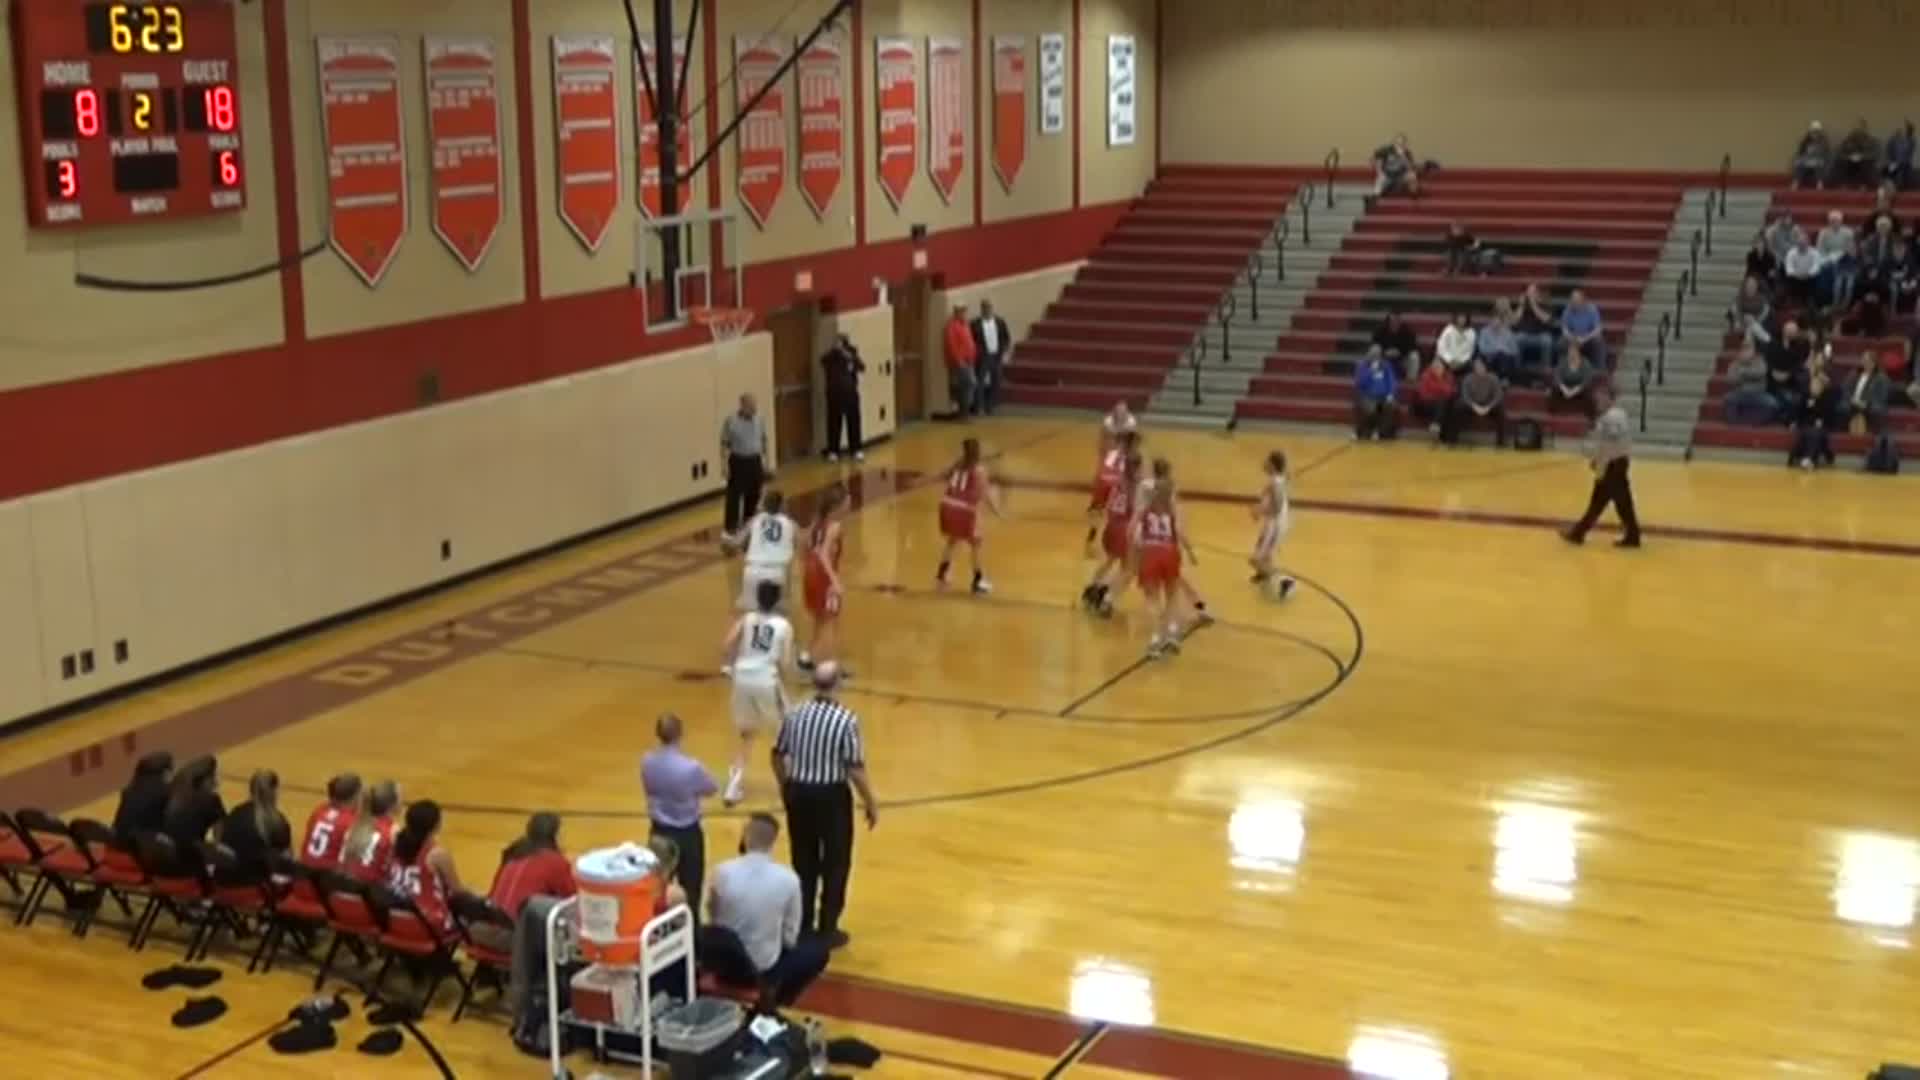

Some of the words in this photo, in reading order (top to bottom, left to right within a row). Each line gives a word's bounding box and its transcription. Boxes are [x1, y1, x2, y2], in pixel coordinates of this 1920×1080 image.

[43, 61, 91, 84] HOME
[182, 60, 229, 83] GUEST
[75, 90, 99, 136] 8
[134, 93, 151, 129] 2
[205, 87, 235, 131] 18
[58, 160, 76, 197] 3
[220, 151, 238, 185] 6
[308, 820, 335, 858] 5
